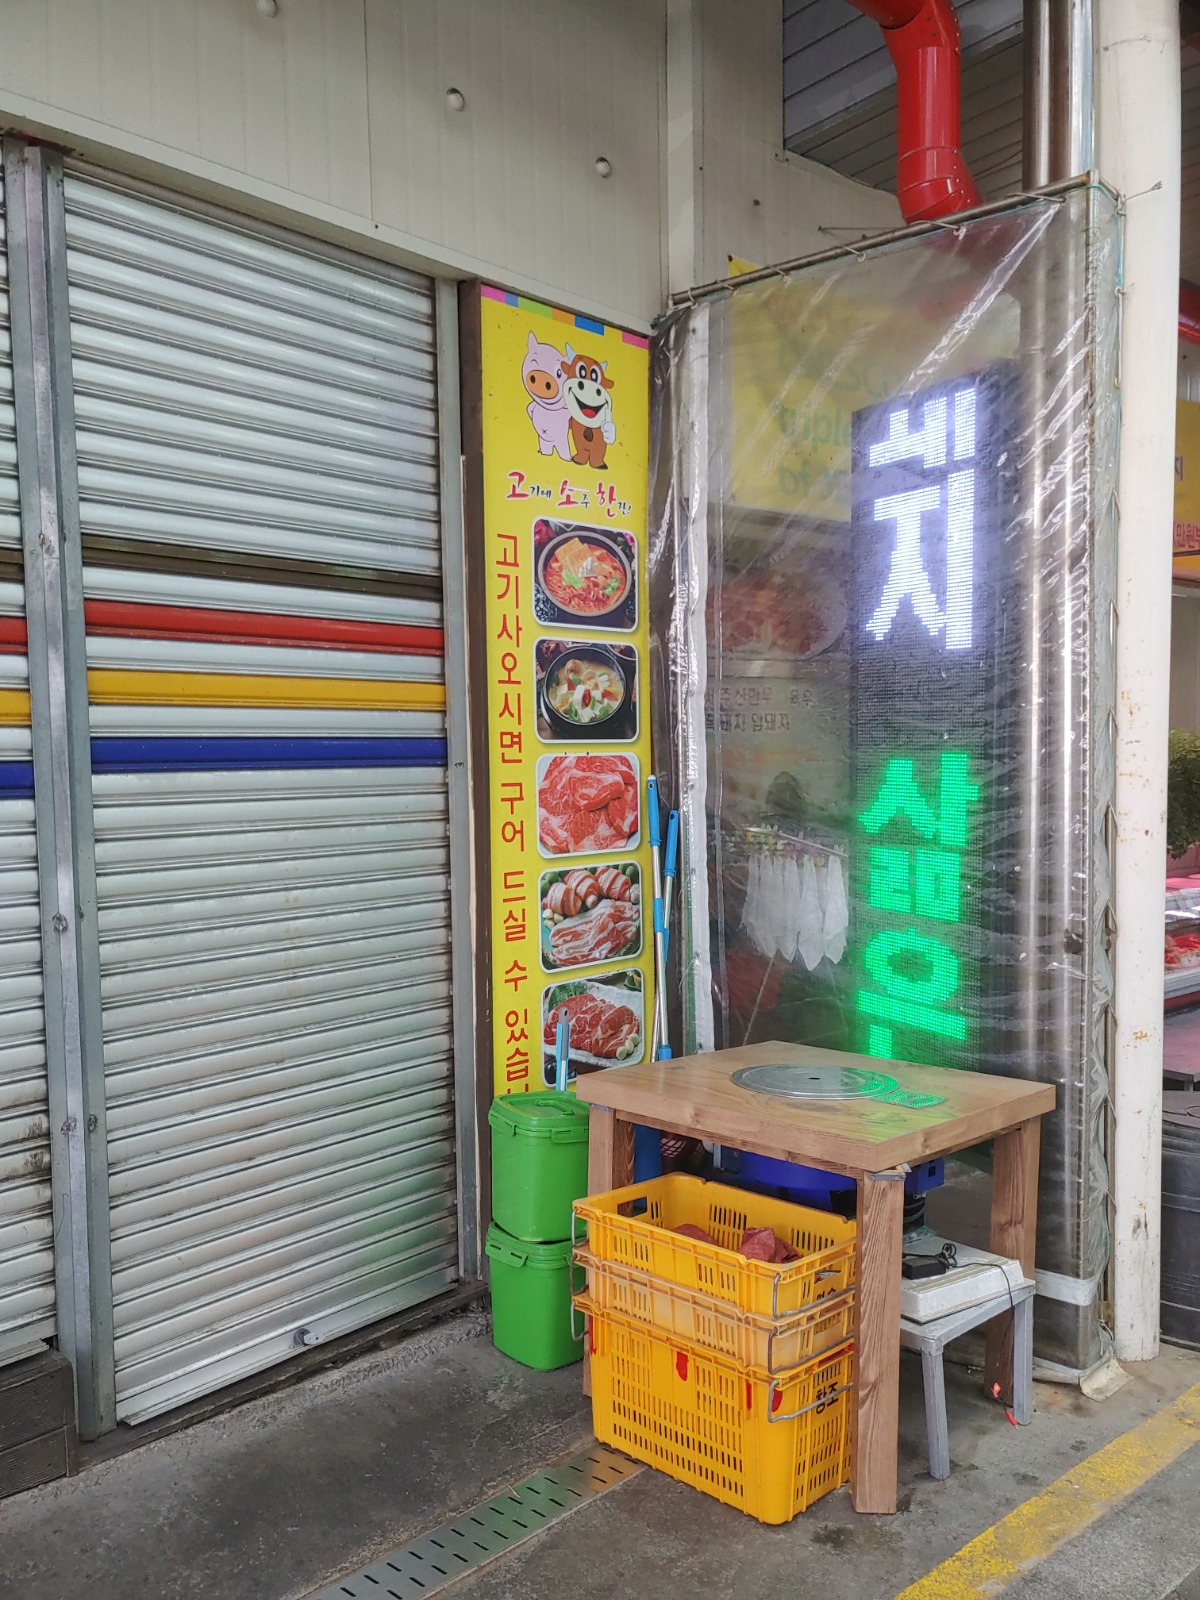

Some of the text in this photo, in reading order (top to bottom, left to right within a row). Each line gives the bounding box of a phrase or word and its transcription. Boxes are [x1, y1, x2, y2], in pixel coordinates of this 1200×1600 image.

[505, 470, 633, 518] 고기에 소주 한잔!
[500, 781, 526, 853] 구어
[501, 869, 528, 944] 드실
[503, 958, 529, 993] 수
